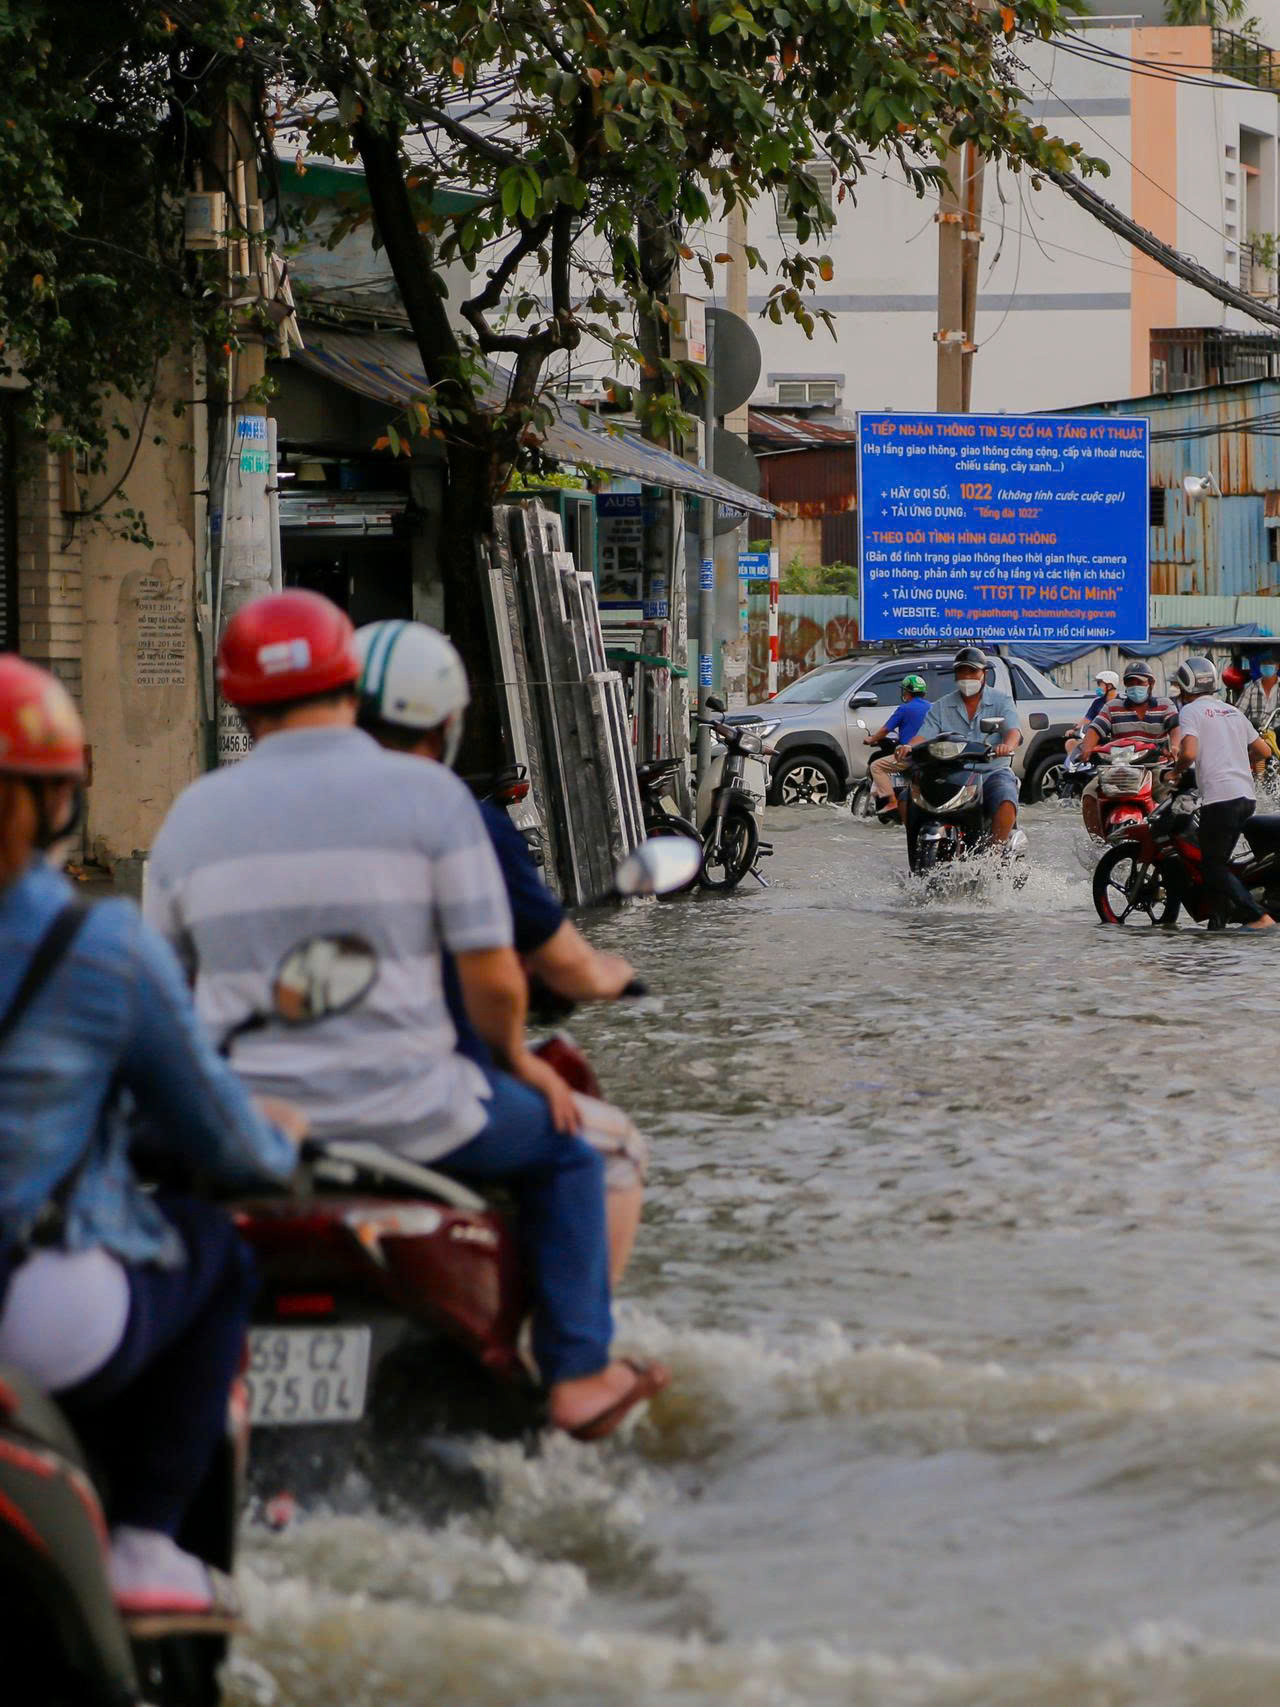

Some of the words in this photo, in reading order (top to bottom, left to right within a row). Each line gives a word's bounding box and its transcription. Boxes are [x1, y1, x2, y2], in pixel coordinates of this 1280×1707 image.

[872, 420, 896, 435] TIẾP
[936, 423, 975, 436] THÔNG
[979, 425, 997, 437] TIN
[999, 426, 1016, 439] SỰ
[1018, 424, 1034, 438] CỐ
[864, 444, 880, 456] (Hạ
[906, 445, 926, 456] giao
[961, 446, 980, 457] giao
[983, 446, 1009, 458] thông
[1011, 446, 1033, 458] công
[1081, 447, 1092, 457] và
[1094, 448, 1117, 457] thoát
[1011, 462, 1026, 473] cây
[890, 486, 910, 498] HÃY
[913, 489, 930, 500] GỌI
[960, 485, 992, 500] 1022
[997, 490, 1032, 502] (không
[1035, 490, 1053, 500] tính
[1055, 491, 1079, 500] cước
[1081, 492, 1104, 502] cuộc
[1105, 492, 1125, 503] gọi)
[891, 503, 907, 516] TẢI
[910, 504, 932, 516] ỨNG
[872, 531, 903, 543] THEO
[928, 529, 955, 543] TÌNH
[958, 532, 986, 544] HÌNH
[989, 533, 1016, 544] GIAO
[1020, 531, 1057, 544] THÔNG
[866, 551, 887, 561] (Bản
[924, 553, 949, 564] trạng
[952, 553, 971, 564] giao
[974, 552, 1001, 564] thông
[1002, 553, 1023, 562] theo
[1025, 553, 1042, 562] thời
[1045, 554, 1064, 565] gian
[870, 568, 890, 580] giao
[924, 567, 947, 580] phản
[950, 568, 967, 578] ánh
[970, 571, 982, 580] sự
[984, 568, 995, 578] cố
[997, 569, 1009, 580] hạ
[1034, 568, 1044, 578] và
[1046, 570, 1062, 578] các
[1064, 570, 1081, 580] tiện
[1084, 570, 1097, 579] ích
[1100, 570, 1125, 579] khác)
[892, 586, 908, 599] TẢI
[911, 587, 933, 599] ỨNG
[1018, 585, 1036, 599] TP
[892, 607, 940, 617] WEBSITE:
[939, 624, 952, 636] SỞ
[953, 628, 974, 636] GIAO
[976, 625, 1005, 638] THÔNG
[1007, 625, 1025, 638] VẬN
[1027, 624, 1041, 636] TẢI
[1071, 626, 1085, 636] CHÍ
[1086, 628, 1116, 636] MINH>
